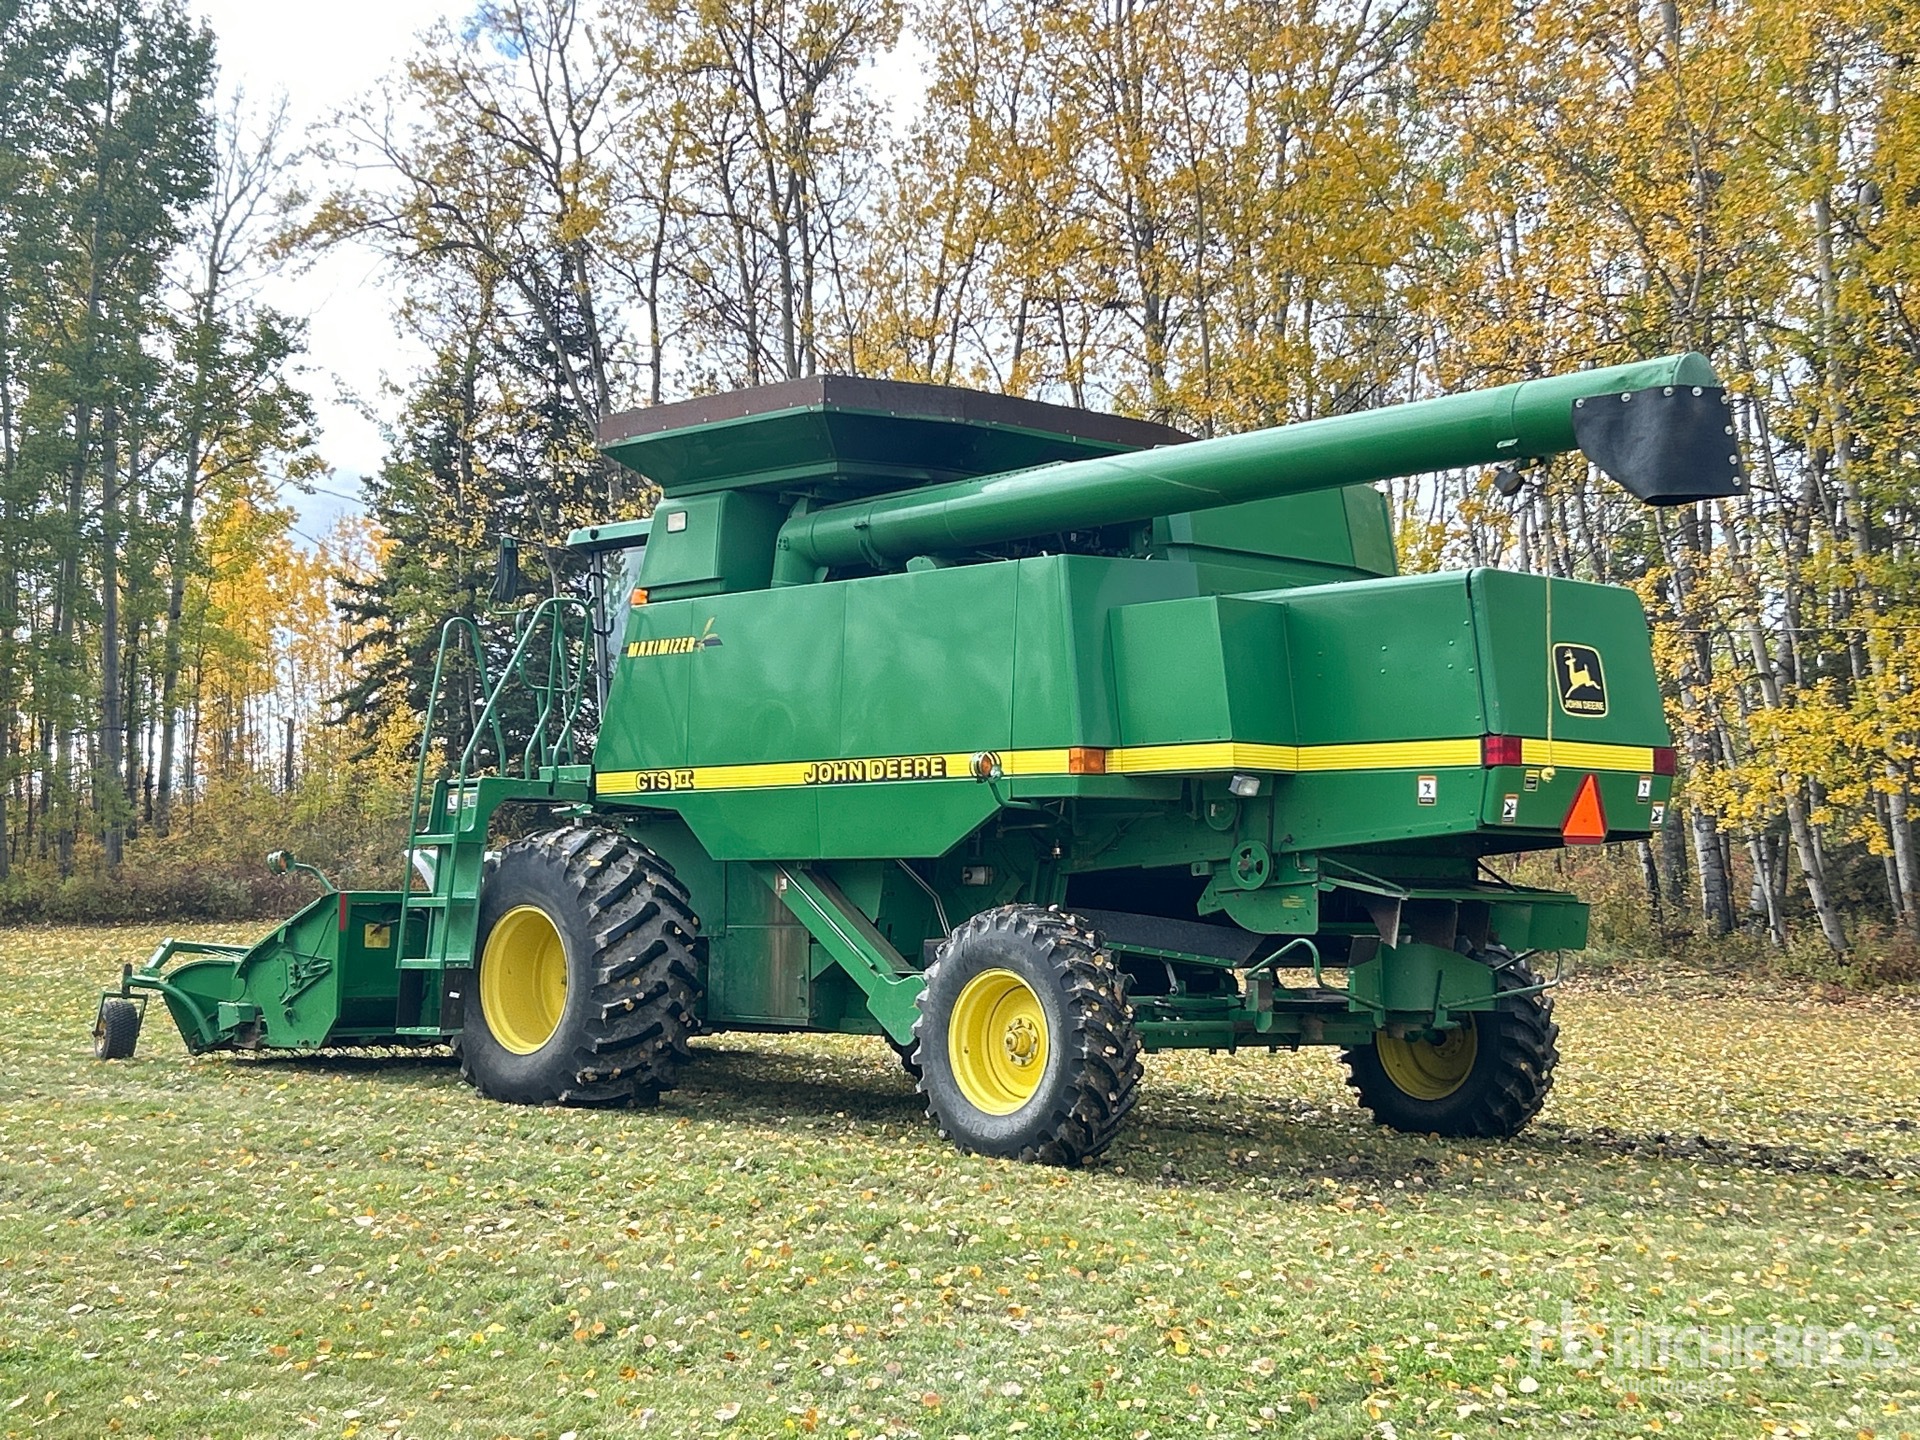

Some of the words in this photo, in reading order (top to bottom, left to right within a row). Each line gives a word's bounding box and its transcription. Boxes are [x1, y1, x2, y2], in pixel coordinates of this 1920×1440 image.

[627, 637, 696, 658] MAXIMIZER
[1565, 699, 1583, 709] JOHN
[1583, 700, 1605, 711] DEERE
[804, 760, 866, 784] JOHN
[870, 757, 946, 781] DEERE
[636, 771, 671, 792] GTS
